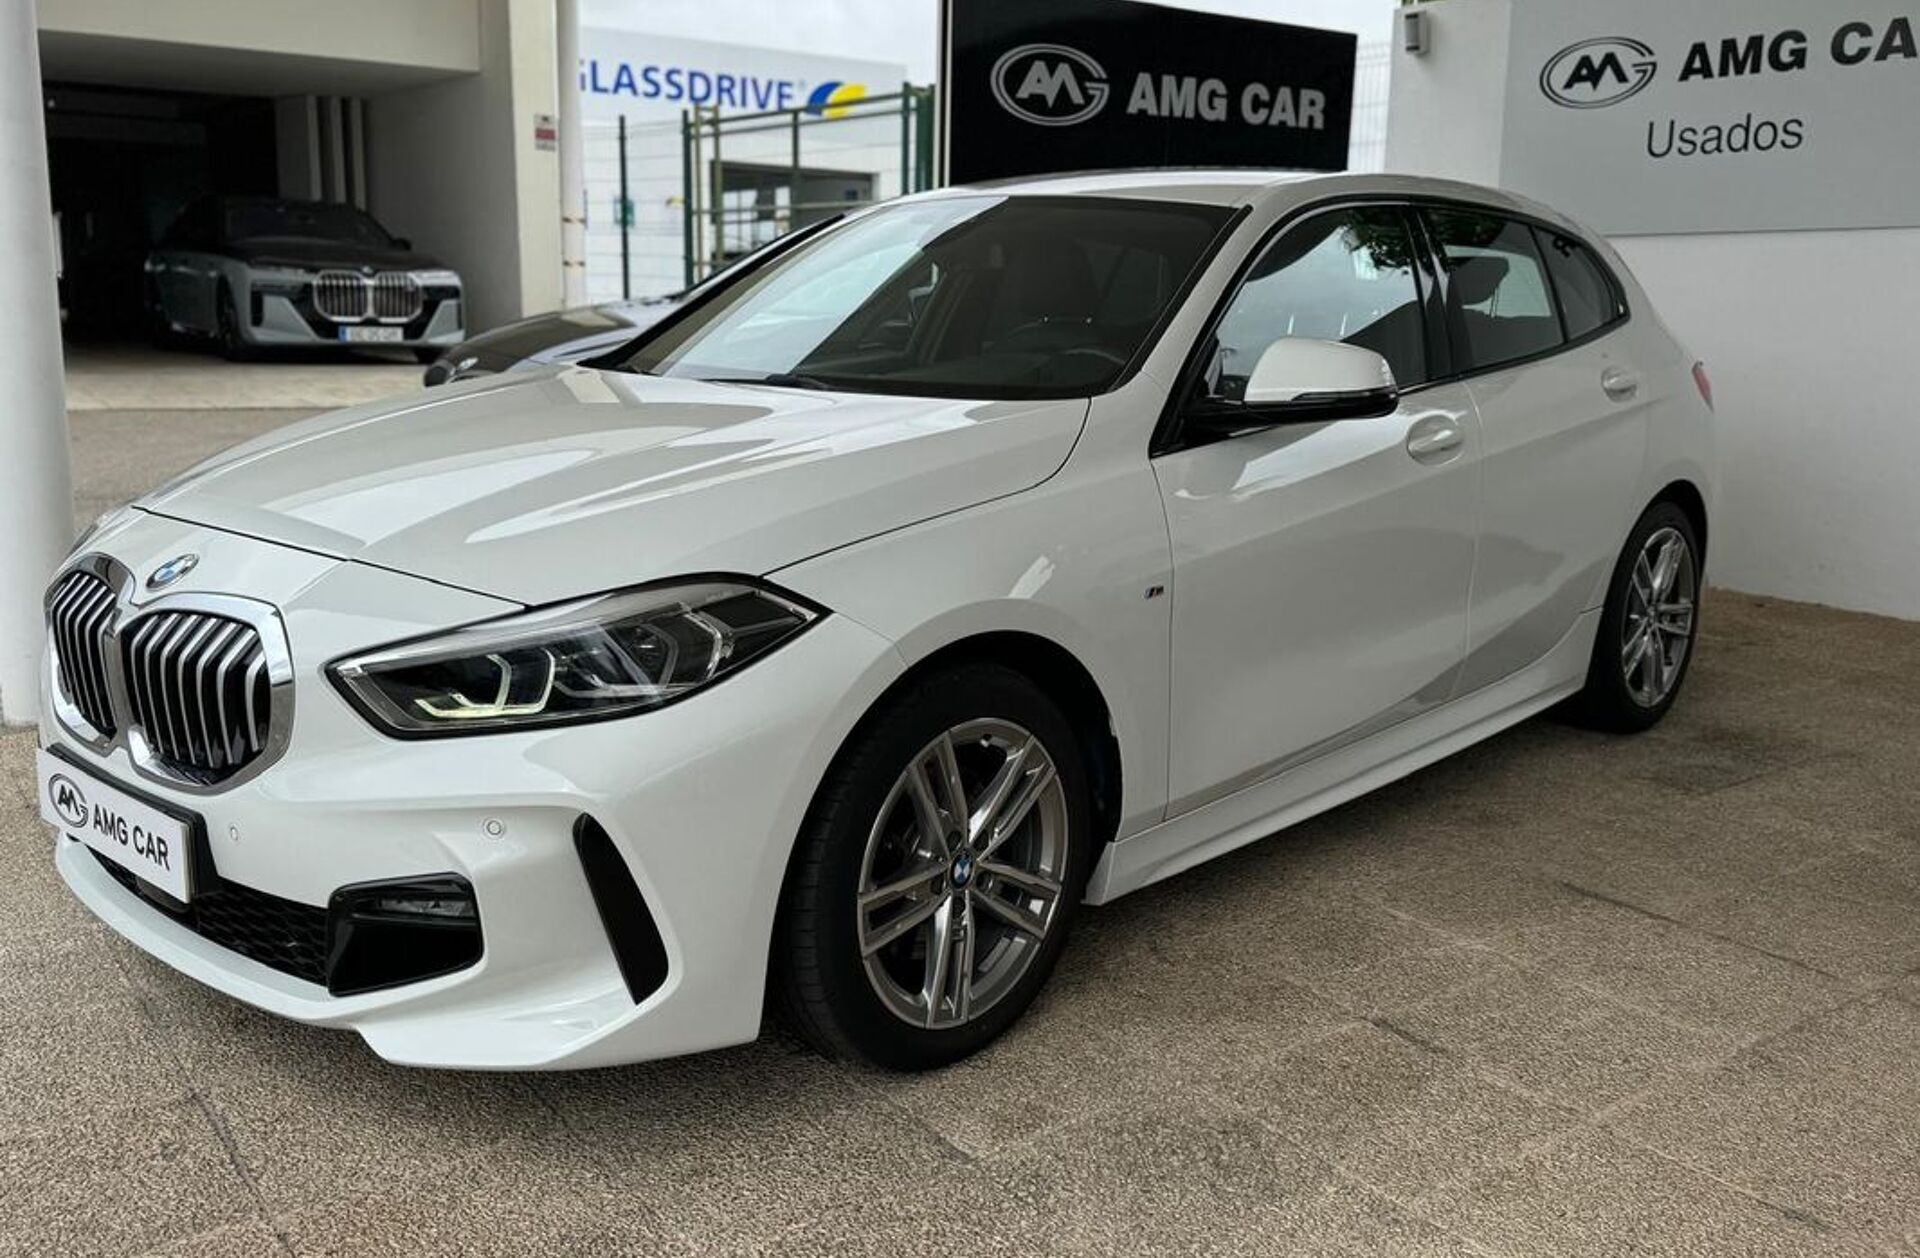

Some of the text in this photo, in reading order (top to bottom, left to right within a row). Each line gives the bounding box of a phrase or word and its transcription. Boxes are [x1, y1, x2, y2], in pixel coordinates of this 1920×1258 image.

[1678, 29, 1807, 82] AMG
[579, 59, 793, 112] LASSDRIVE
[1126, 72, 1326, 130] AMG CAR
[1647, 113, 1803, 158] Usados
[94, 803, 170, 871] AMG CAR
